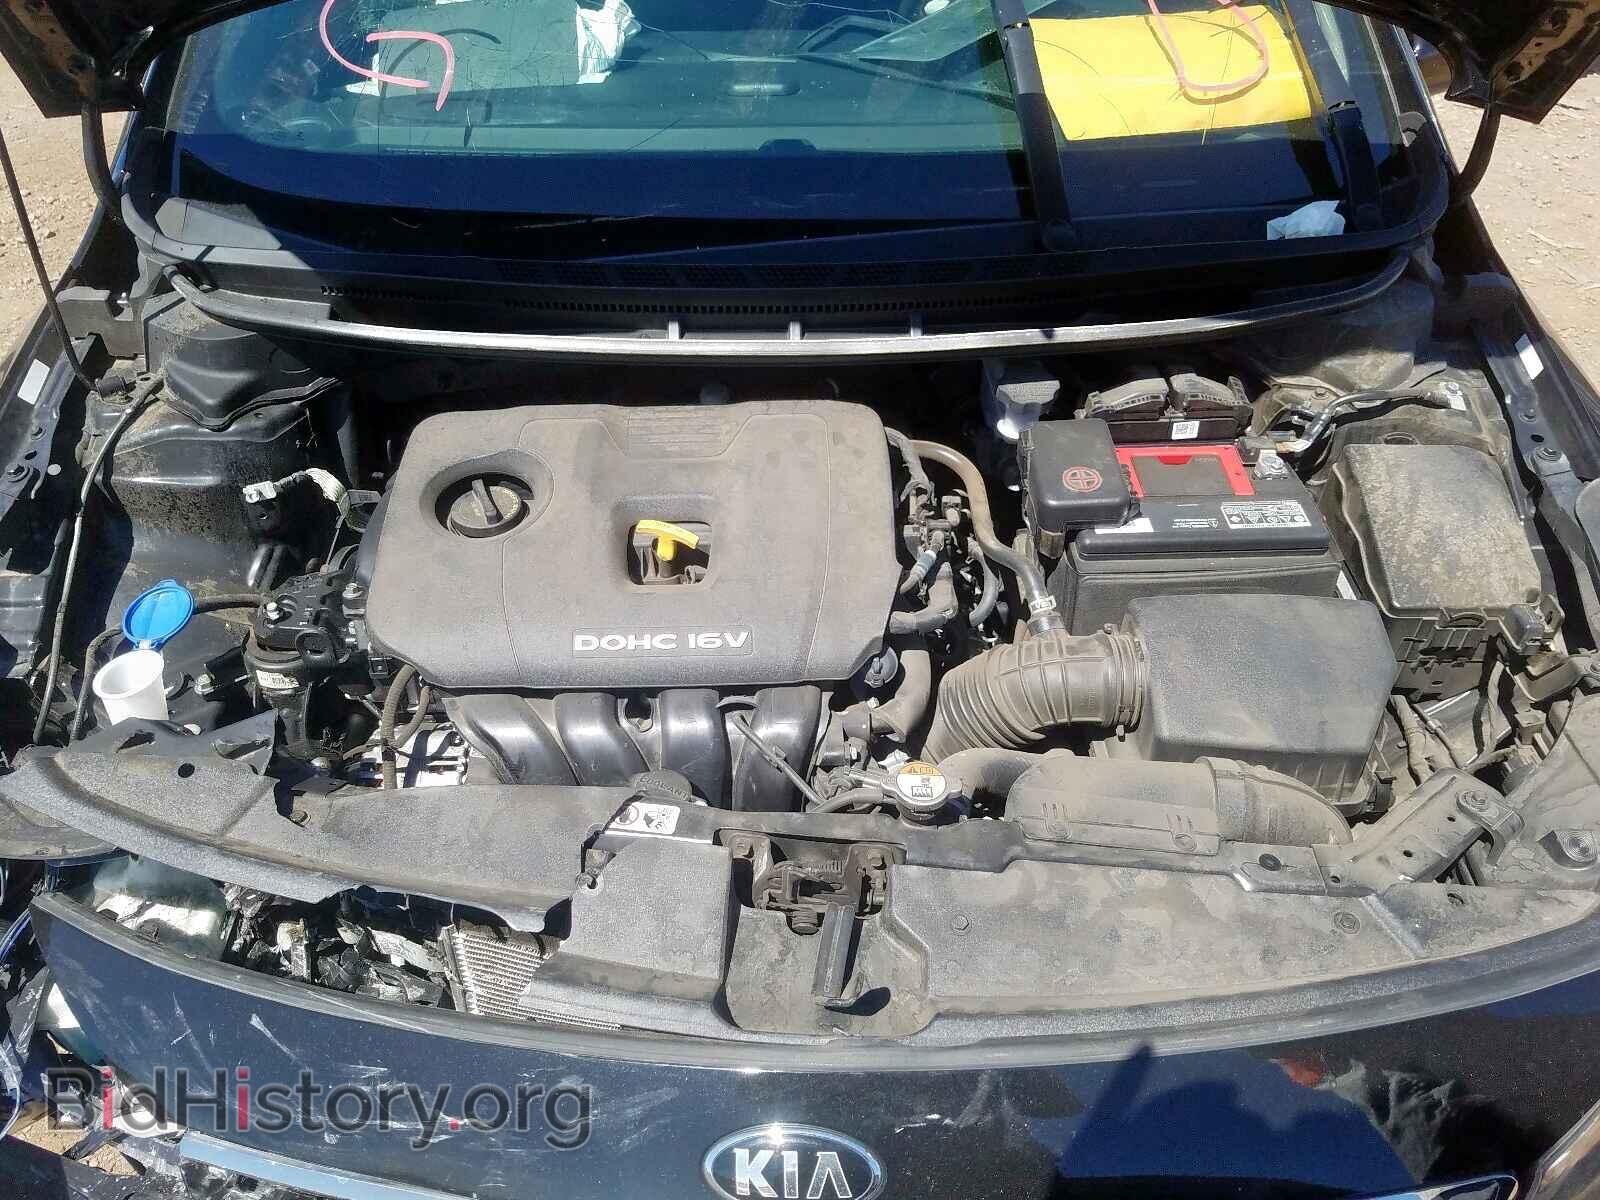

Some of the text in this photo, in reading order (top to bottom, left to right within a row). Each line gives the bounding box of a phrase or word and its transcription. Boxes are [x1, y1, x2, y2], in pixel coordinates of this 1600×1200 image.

[574, 631, 749, 651] DOHC 16V
[733, 1148, 853, 1200] KIA
